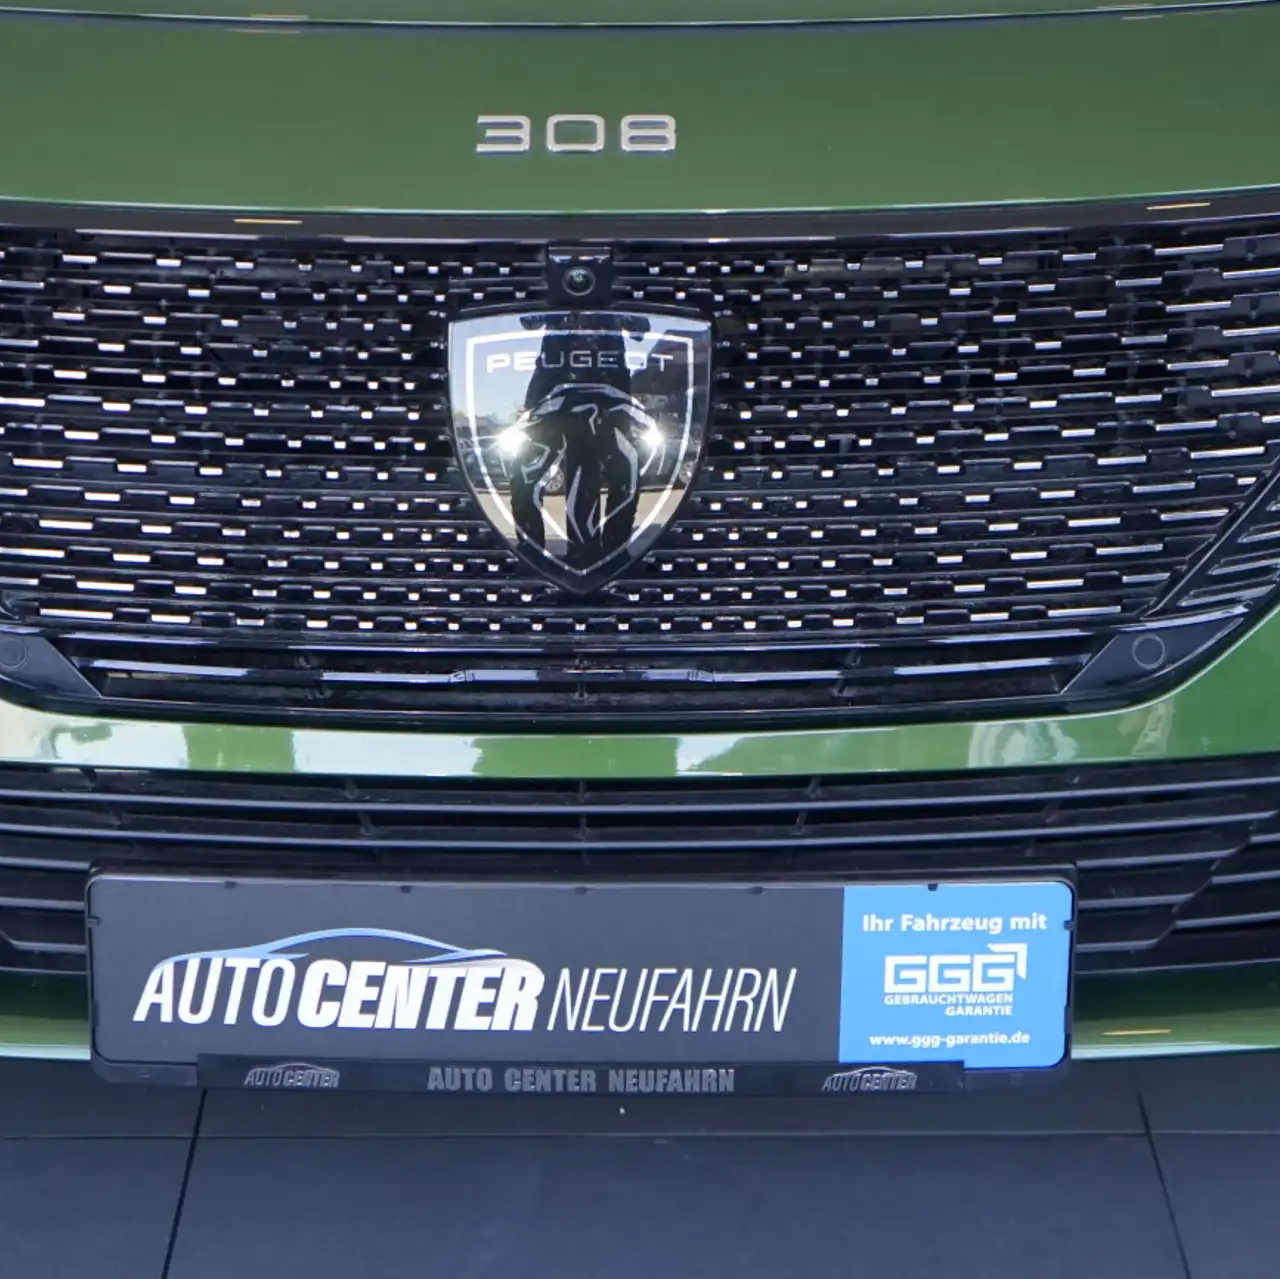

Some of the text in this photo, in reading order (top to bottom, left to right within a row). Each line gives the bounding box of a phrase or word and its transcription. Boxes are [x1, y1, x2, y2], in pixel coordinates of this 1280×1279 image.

[476, 114, 676, 152] 308
[486, 350, 674, 374] PEUGEOT
[863, 912, 1048, 934] Ihr Fahrzeug mit
[883, 954, 1016, 993] GGG
[547, 967, 797, 1033] NEUFAHRN
[883, 993, 1014, 1006] GEBRAUCHTWAGEN
[945, 1005, 1013, 1017] GARANTIE
[869, 1031, 1032, 1048] www.ggg-garantie.de
[426, 1068, 735, 1093] AUTO CENTER NEUFAHRN
